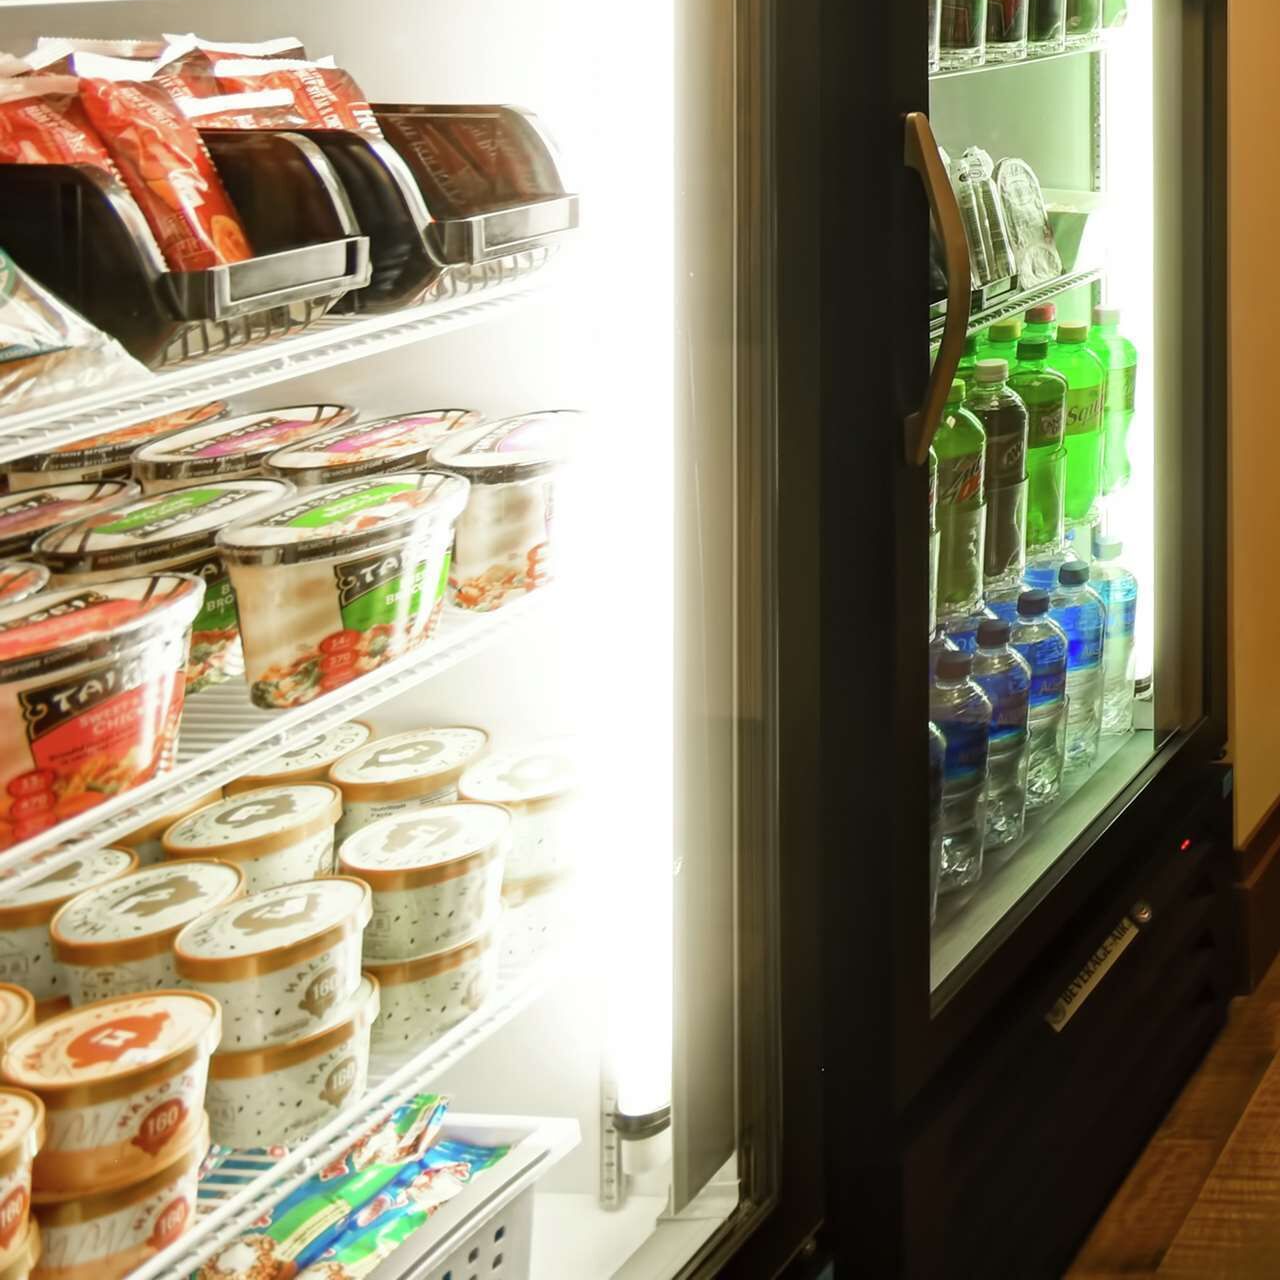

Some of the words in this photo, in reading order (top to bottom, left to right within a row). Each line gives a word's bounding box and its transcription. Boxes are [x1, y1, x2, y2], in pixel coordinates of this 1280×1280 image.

[285, 953, 330, 993] HALO
[1062, 918, 1132, 1007] BEVERAGE-AIR
[314, 974, 337, 998] 160
[306, 1042, 349, 1084] HALO
[331, 1068, 354, 1090] 160
[119, 1080, 171, 1128] HALO
[150, 1108, 179, 1135] 160
